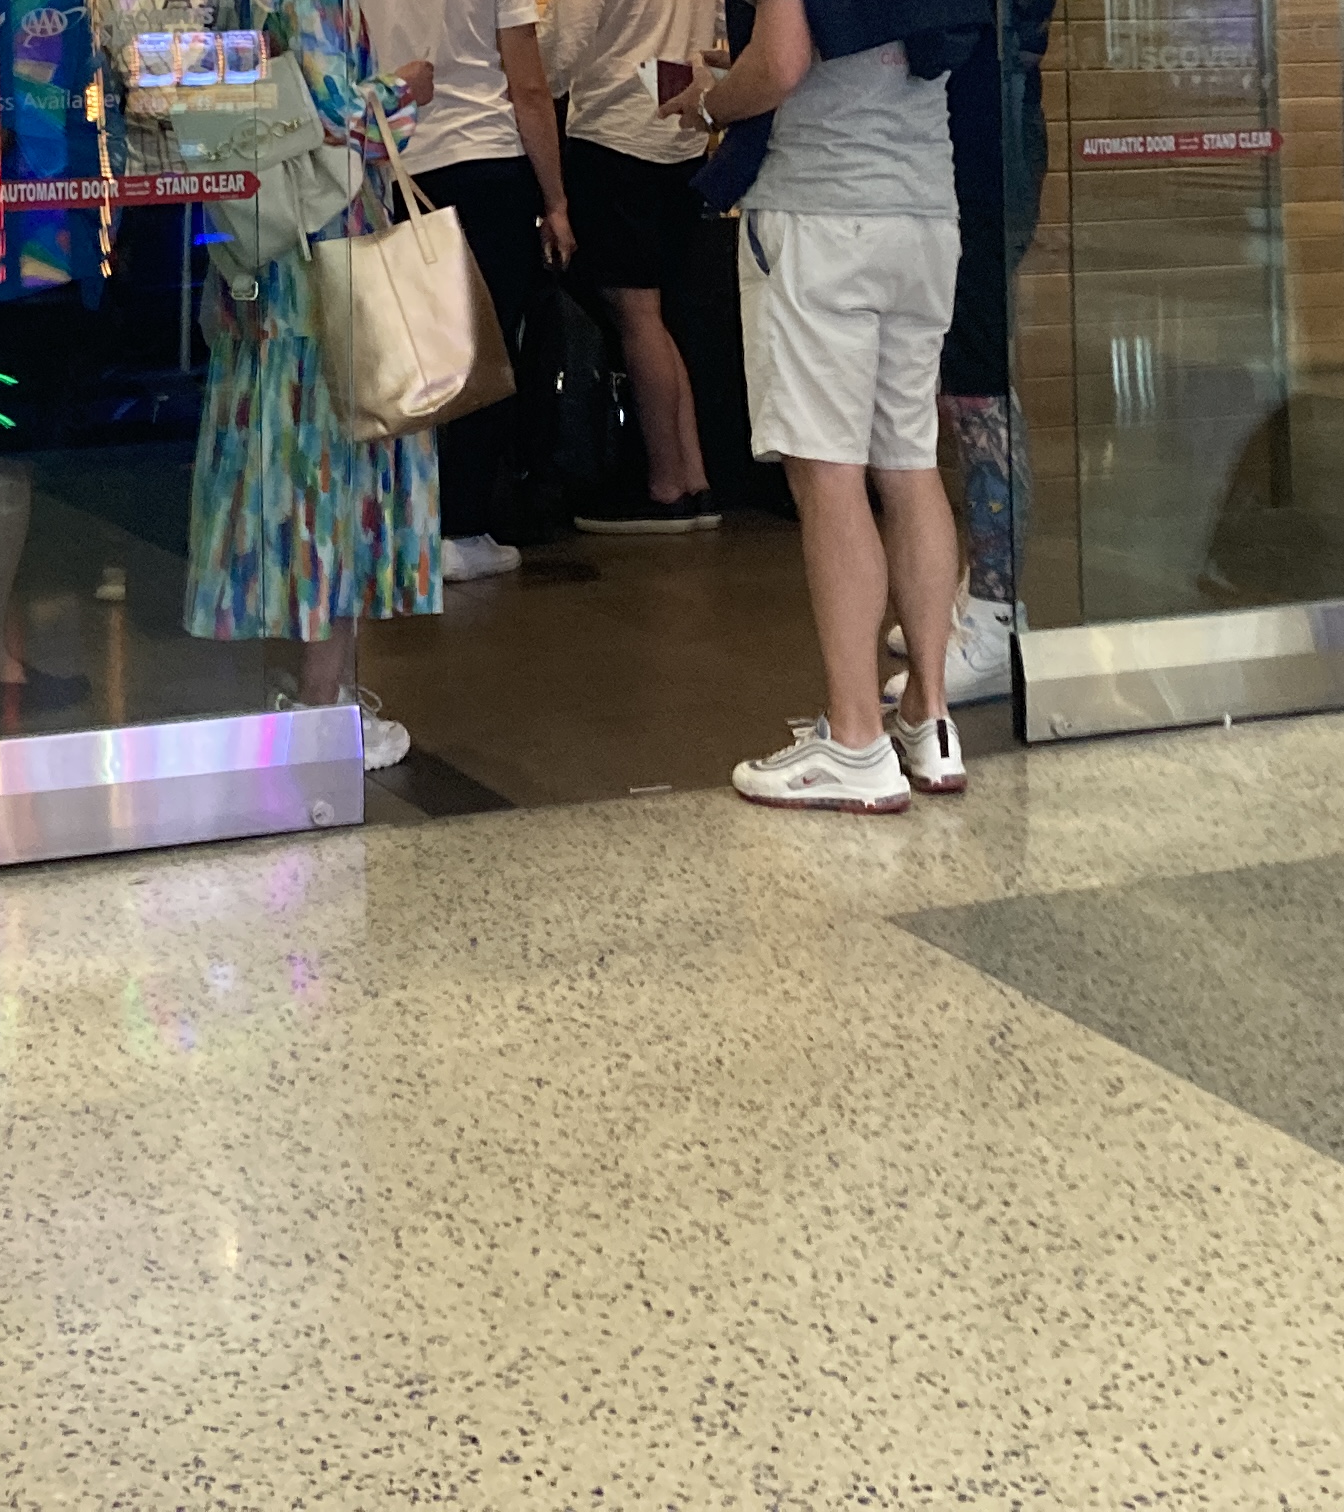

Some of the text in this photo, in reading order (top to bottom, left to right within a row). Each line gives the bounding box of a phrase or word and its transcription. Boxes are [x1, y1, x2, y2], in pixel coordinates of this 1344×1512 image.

[24, 12, 64, 35] AAA
[24, 91, 115, 110] Availae
[1083, 131, 1273, 155] AUTOMATIC DOOR STAND CLEAR
[0, 181, 78, 203] AUTOMATIC
[81, 180, 119, 199] DOOR
[156, 176, 199, 196] STAND
[202, 174, 246, 194] CLEAR
